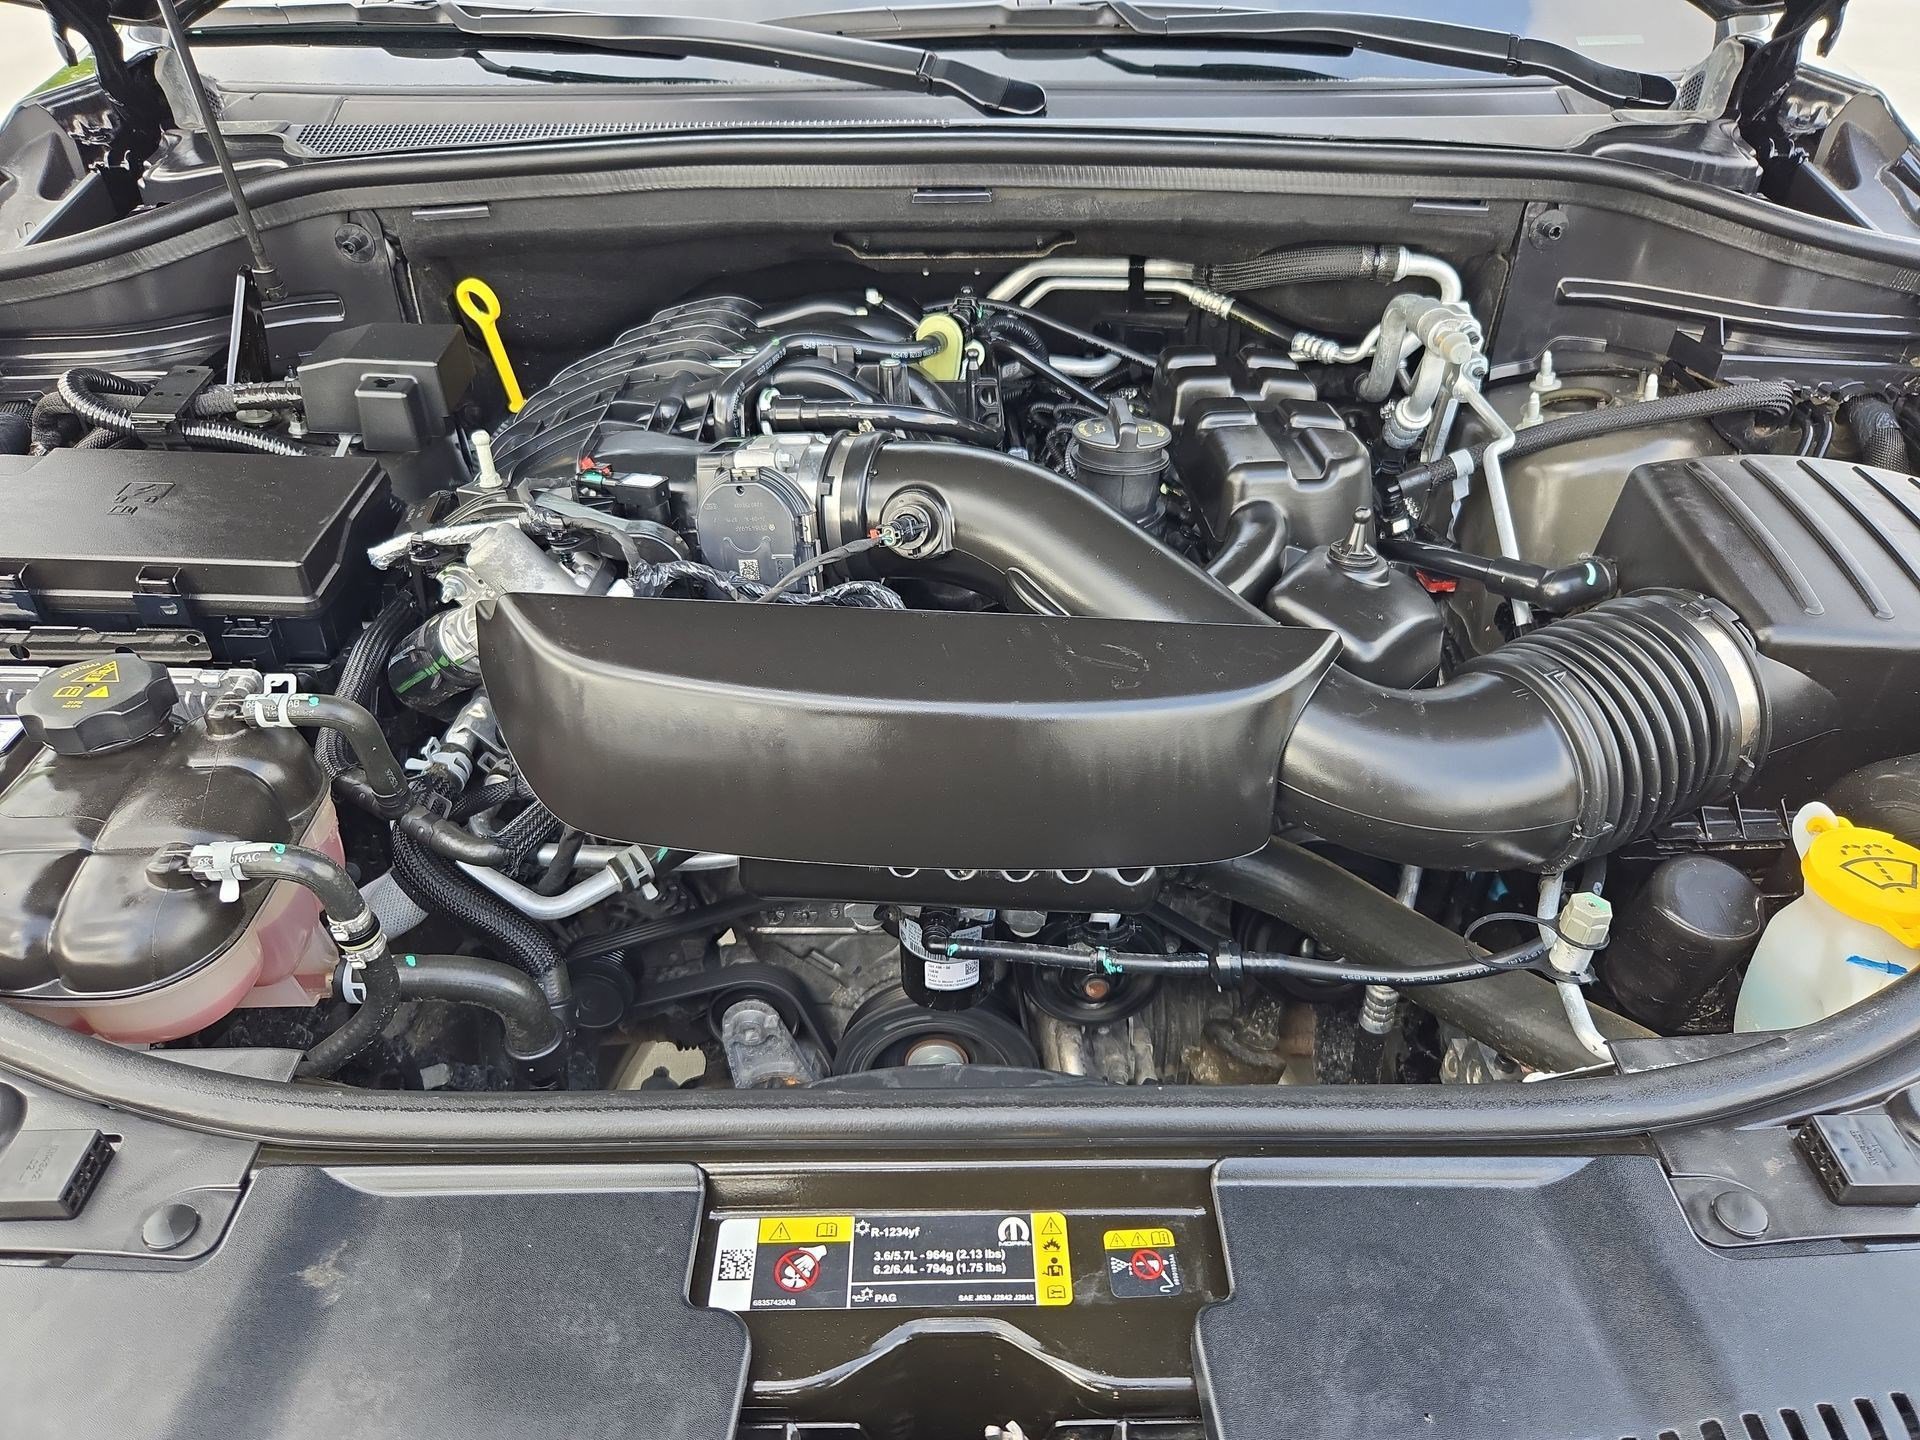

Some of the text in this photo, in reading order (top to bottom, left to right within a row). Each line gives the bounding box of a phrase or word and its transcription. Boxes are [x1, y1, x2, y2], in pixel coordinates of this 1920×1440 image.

[870, 1226, 920, 1239] R-1234yf
[873, 1250, 918, 1261] 3.6/5.7L
[956, 1248, 983, 1261] (2.13
[984, 1248, 1006, 1261] lbs)
[873, 1263, 918, 1275] 6.2/6.4L
[925, 1263, 954, 1276] 794g
[956, 1262, 984, 1275] (1.75
[985, 1261, 1007, 1275] lbs)
[874, 1293, 898, 1303] PAG
[958, 1294, 974, 1302] SAE
